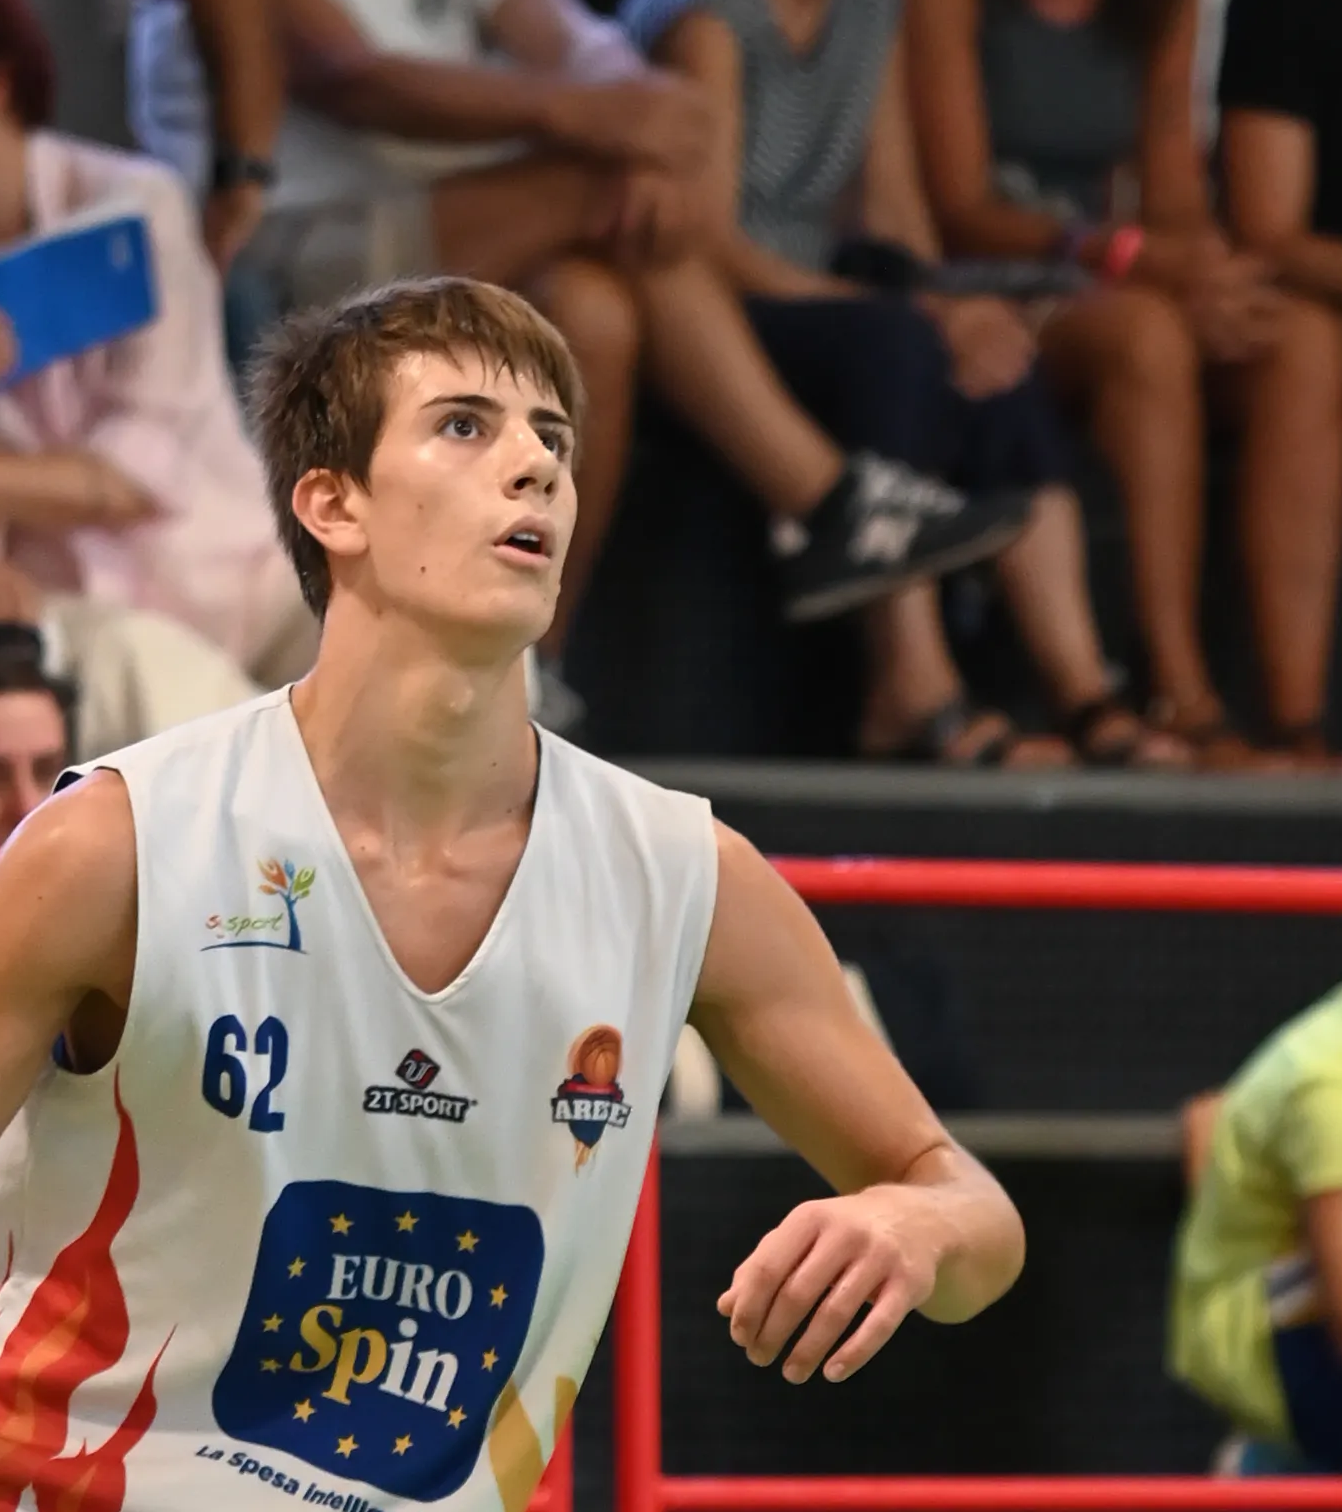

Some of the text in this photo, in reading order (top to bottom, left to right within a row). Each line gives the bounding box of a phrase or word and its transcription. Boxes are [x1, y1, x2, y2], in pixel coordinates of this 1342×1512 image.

[202, 1013, 290, 1133] 62
[367, 1090, 467, 1120] 2T SPORT
[325, 1253, 473, 1320] EURO
[290, 1304, 459, 1412] Spin
[195, 1445, 225, 1461] La
[226, 1451, 301, 1496] Spesa
